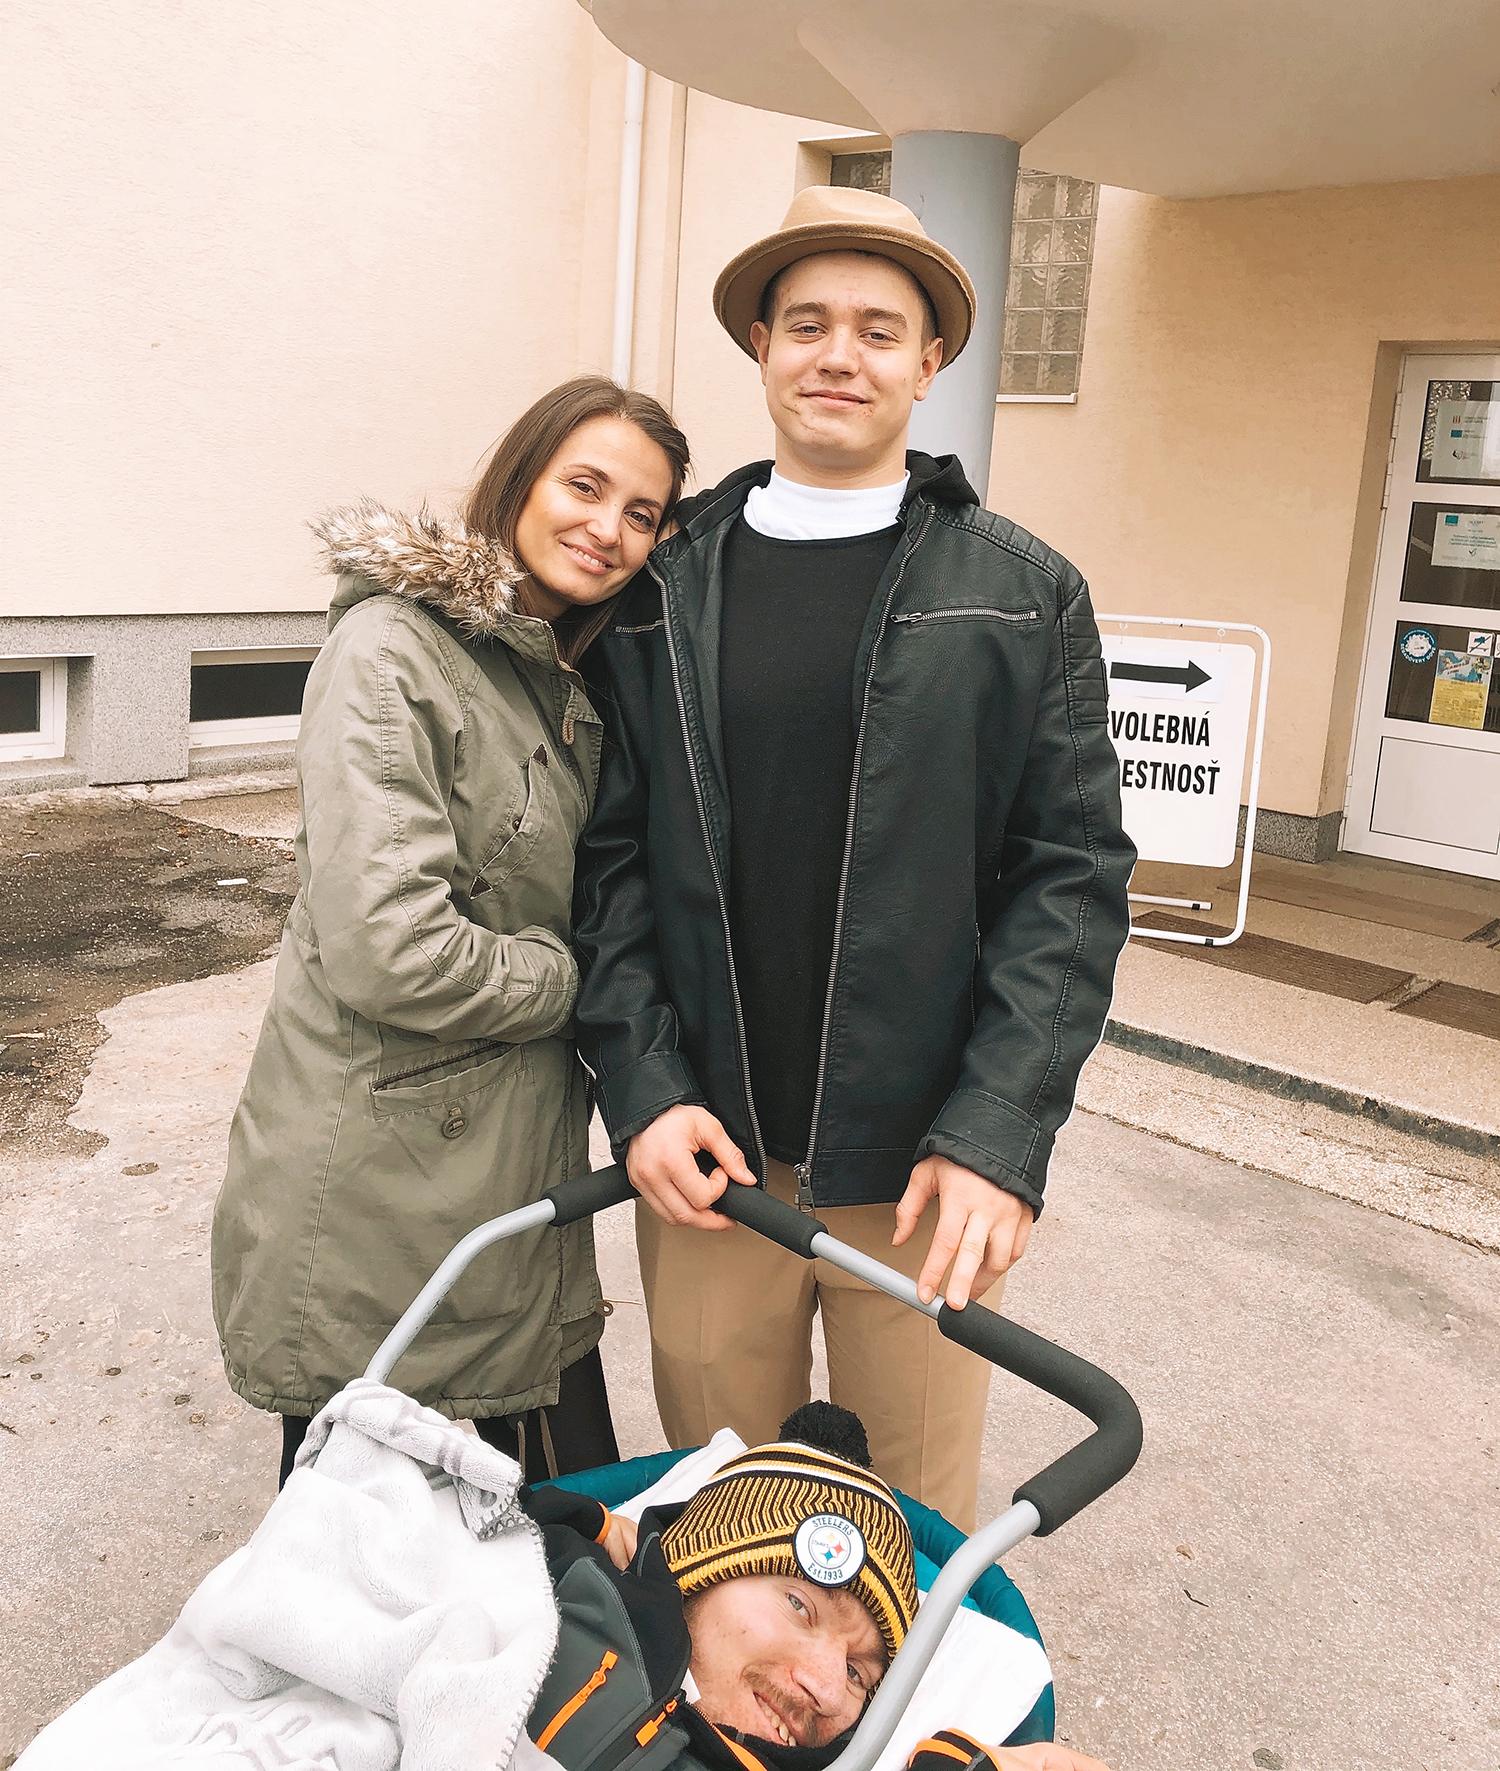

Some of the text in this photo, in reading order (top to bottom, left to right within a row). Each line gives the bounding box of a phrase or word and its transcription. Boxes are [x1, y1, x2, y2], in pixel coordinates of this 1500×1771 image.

[1111, 710, 1210, 747] VOLEBNÁ
[1119, 759, 1220, 795] ESTNOSŤ
[811, 1517, 854, 1536] STEELERS
